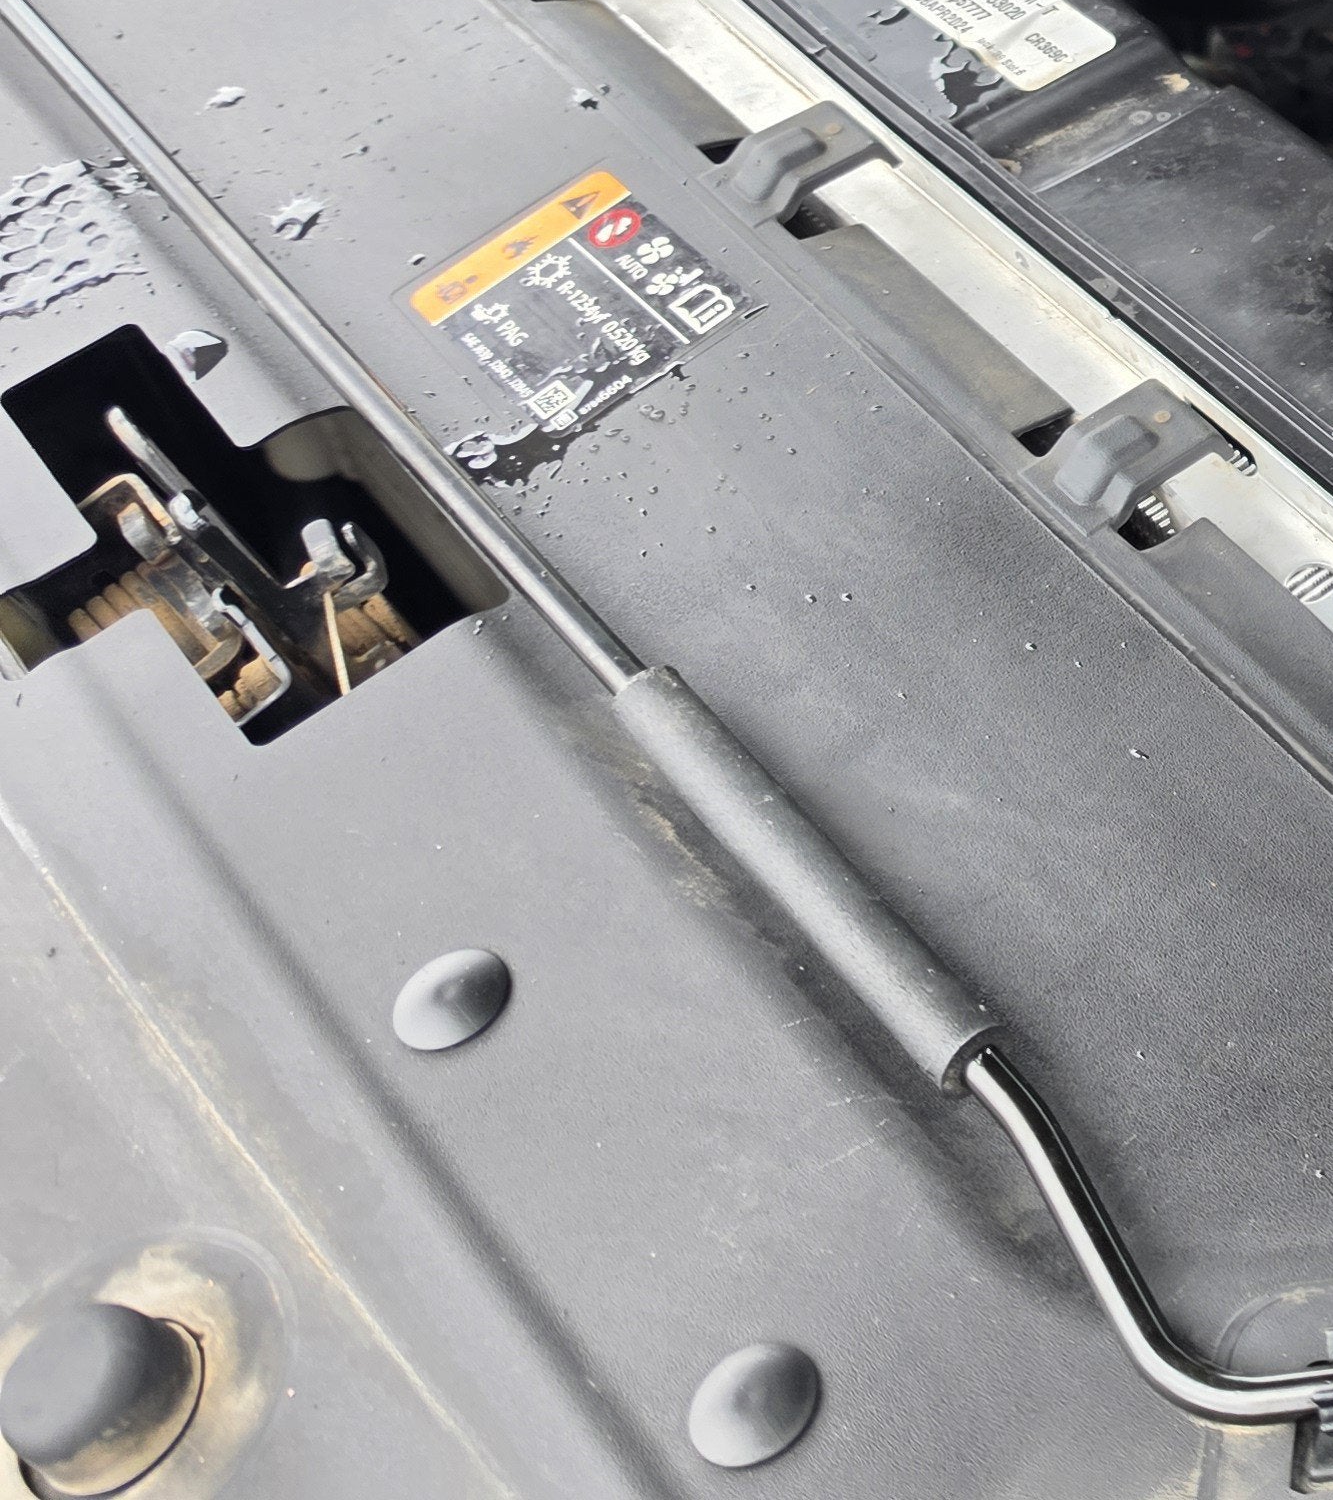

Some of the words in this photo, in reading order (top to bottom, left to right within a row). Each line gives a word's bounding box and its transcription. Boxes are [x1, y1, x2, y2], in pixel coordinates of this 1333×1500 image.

[614, 254, 649, 281] AUTO
[556, 280, 612, 325] R-1234yf
[495, 320, 530, 347] PAG
